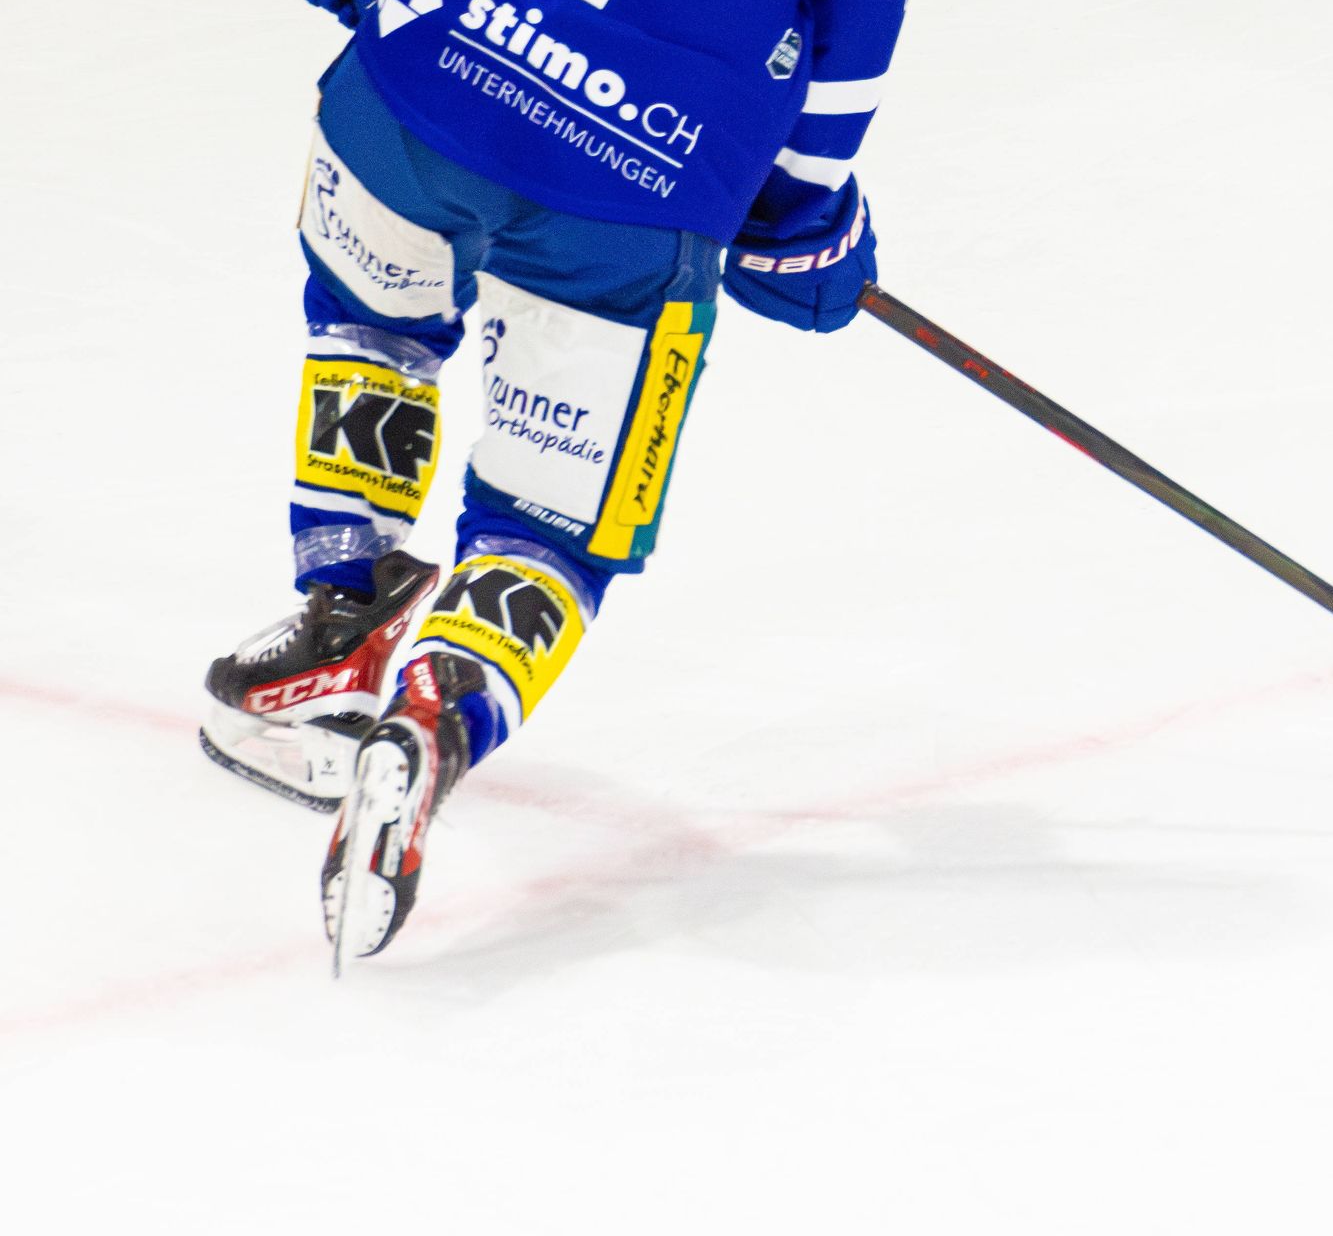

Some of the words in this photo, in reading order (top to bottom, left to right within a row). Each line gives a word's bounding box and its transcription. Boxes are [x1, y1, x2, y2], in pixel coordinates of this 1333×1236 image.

[438, 46, 677, 198] UNTERNEHMUNGEN
[310, 389, 436, 482] KF
[488, 408, 605, 465] Orthopädie
[247, 667, 353, 715] CCM
